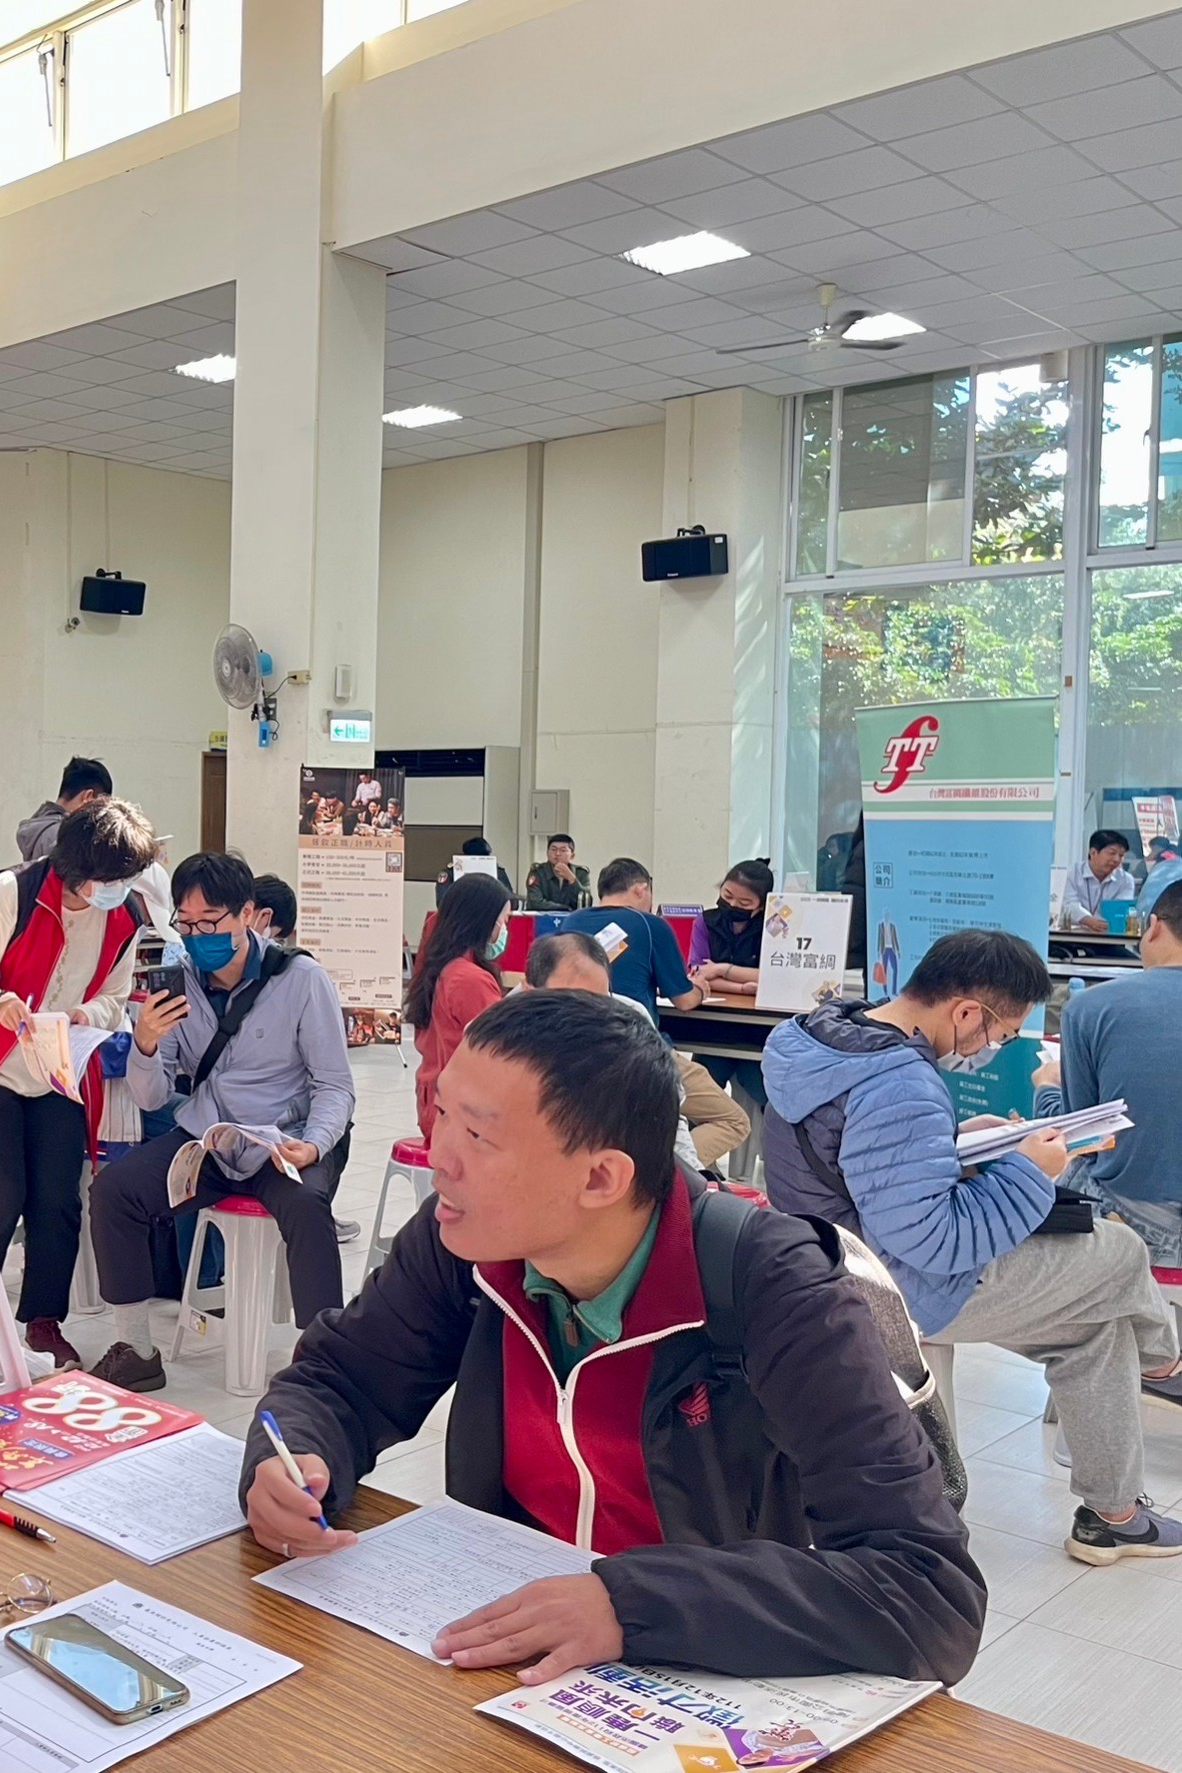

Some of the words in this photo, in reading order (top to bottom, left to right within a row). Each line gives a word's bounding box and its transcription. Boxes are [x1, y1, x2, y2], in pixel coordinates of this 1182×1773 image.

[796, 937, 812, 950] 17
[22, 1391, 163, 1431] 88
[547, 1689, 660, 1740] 一鹿順風
